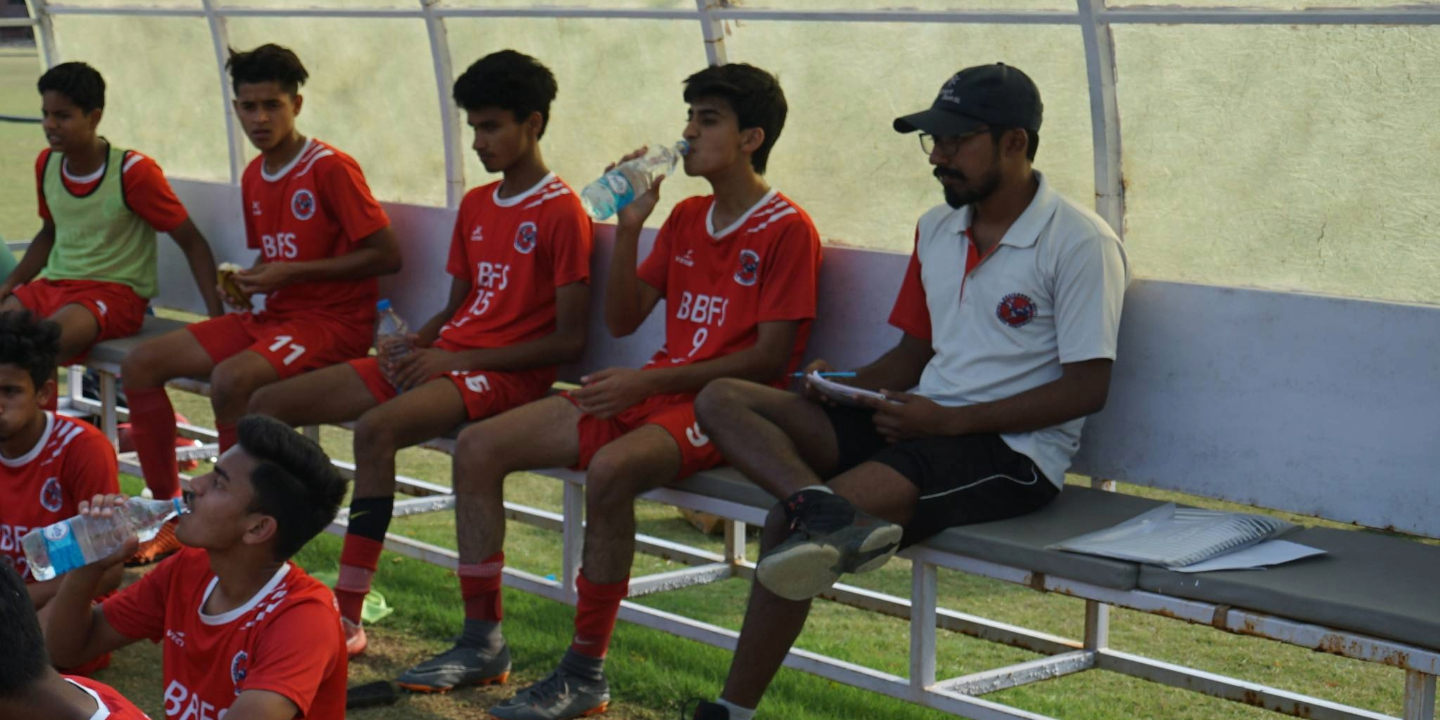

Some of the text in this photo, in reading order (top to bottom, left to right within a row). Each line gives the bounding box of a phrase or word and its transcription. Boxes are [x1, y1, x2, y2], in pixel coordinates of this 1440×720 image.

[469, 290, 494, 315] 15
[677, 291, 729, 327] BBFS
[269, 335, 306, 365] 11
[688, 327, 708, 357] 9
[164, 679, 229, 720] BBF
